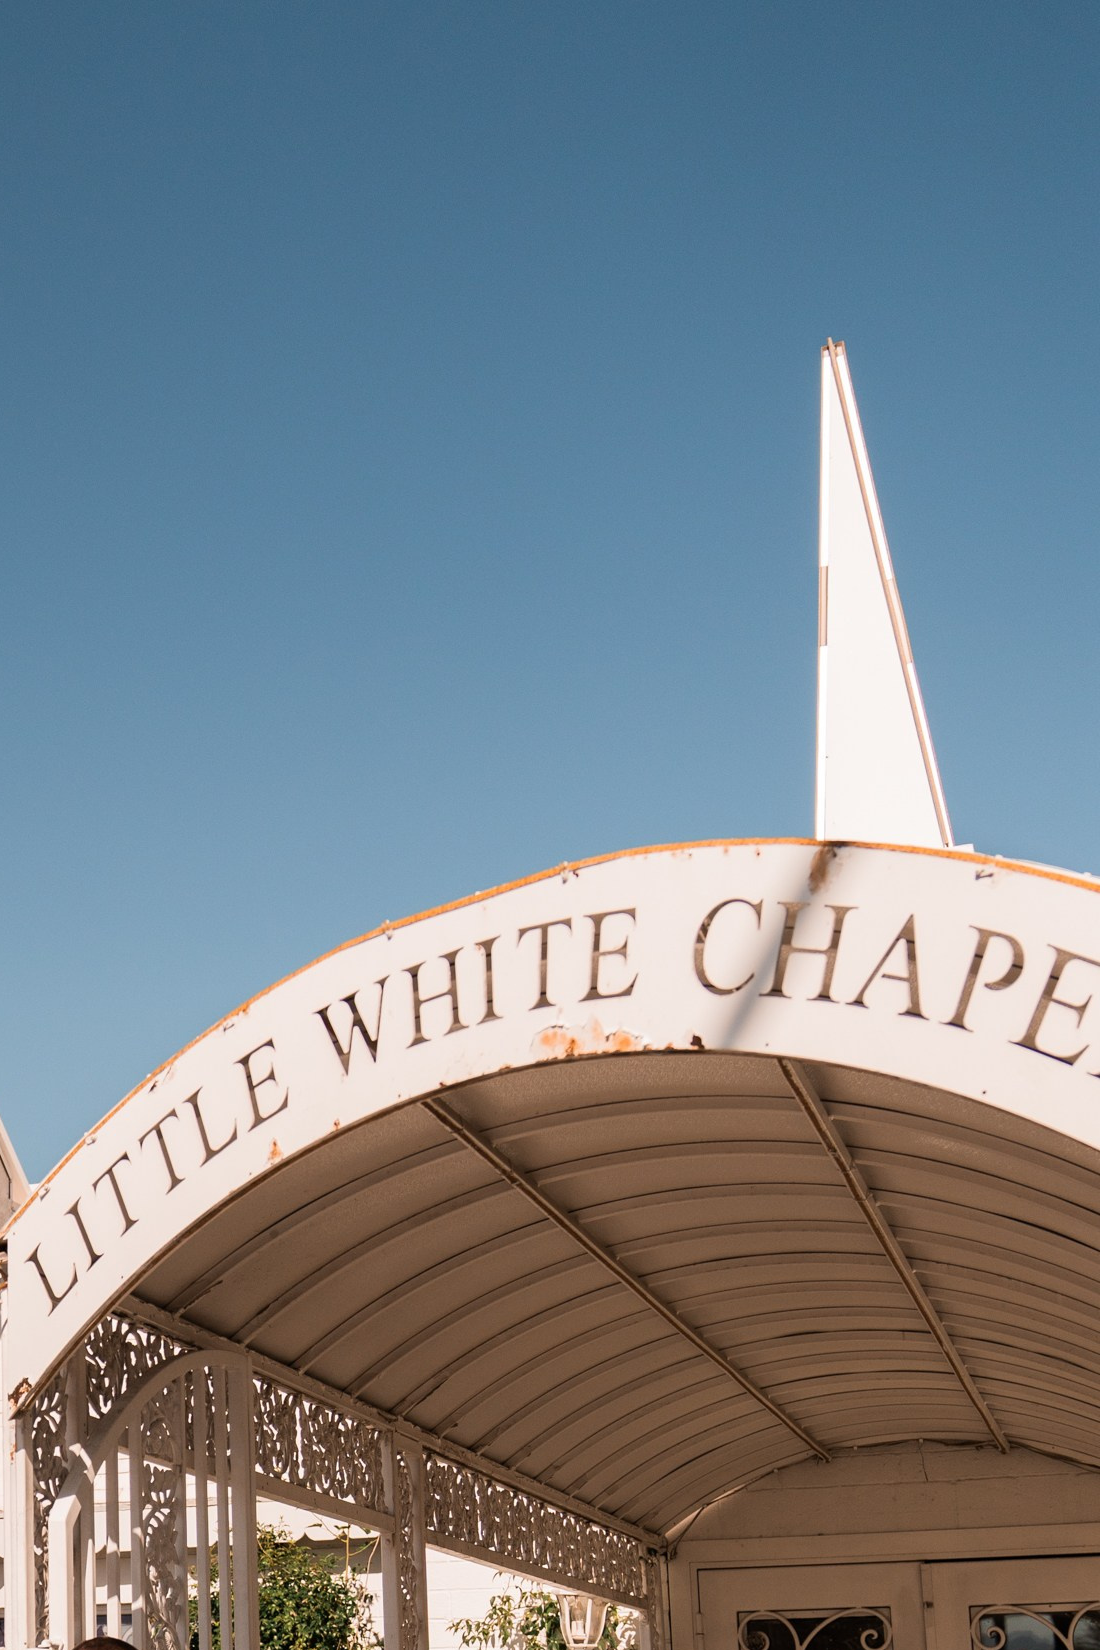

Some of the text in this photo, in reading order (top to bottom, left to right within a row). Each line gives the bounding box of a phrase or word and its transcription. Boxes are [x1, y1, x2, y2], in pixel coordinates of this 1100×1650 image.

[23, 897, 1100, 1317] LITTLE WHITE CHAPE
